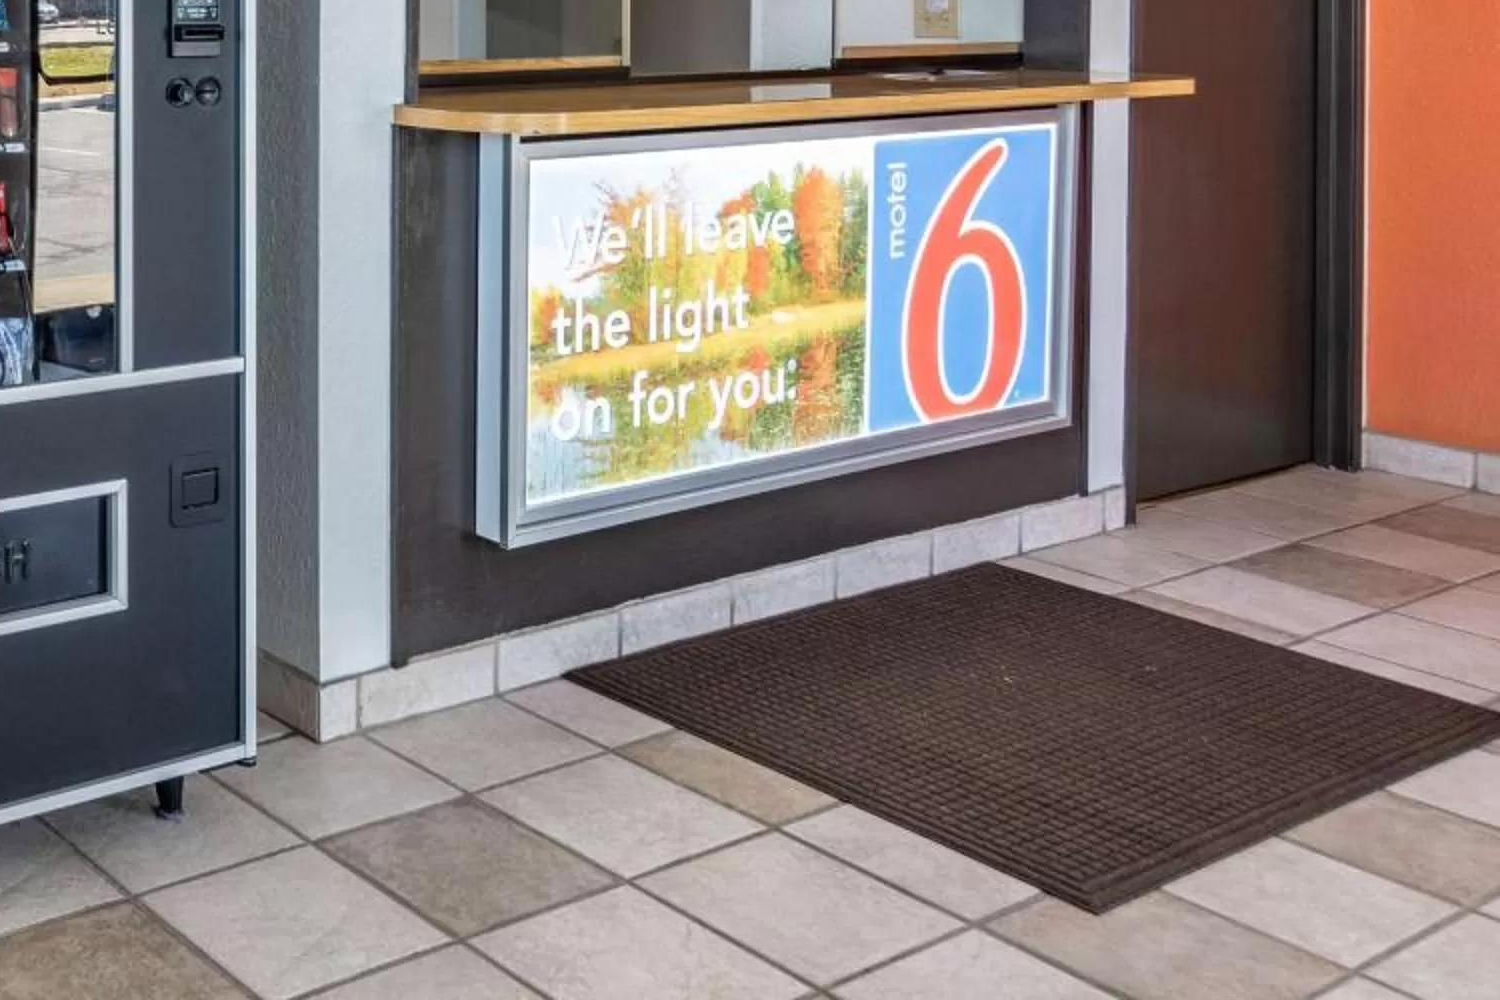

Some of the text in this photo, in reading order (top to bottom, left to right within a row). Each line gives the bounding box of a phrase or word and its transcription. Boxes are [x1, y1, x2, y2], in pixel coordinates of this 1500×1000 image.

[552, 201, 796, 272] We'll leave
[886, 162, 909, 260] motel
[551, 279, 750, 356] the light
[901, 137, 1028, 425] 6
[552, 393, 611, 441] on
[631, 370, 695, 428] for
